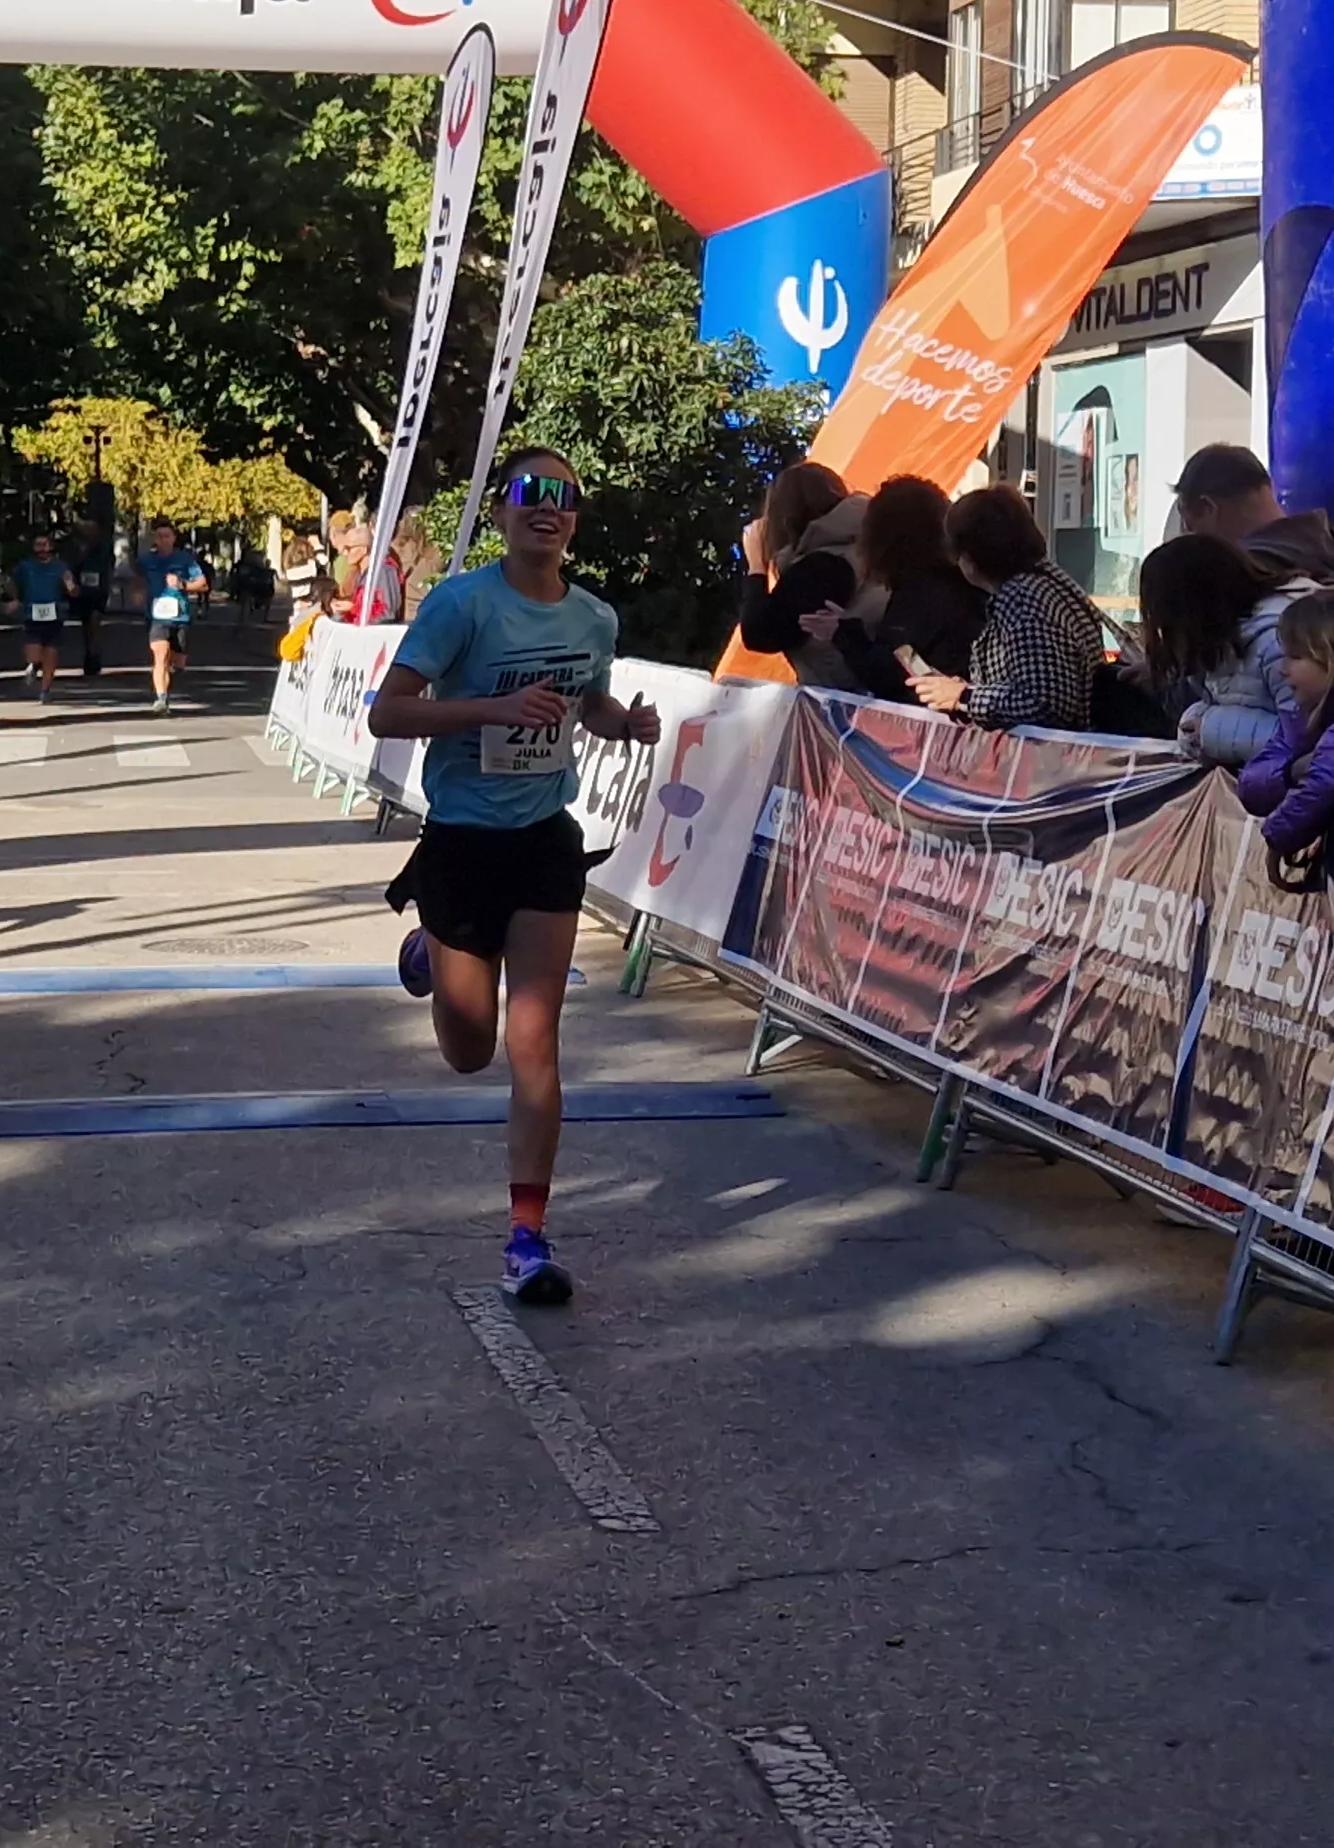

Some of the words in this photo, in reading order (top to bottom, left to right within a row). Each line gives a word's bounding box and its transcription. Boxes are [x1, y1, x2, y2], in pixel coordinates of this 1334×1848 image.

[859, 349, 984, 424] deporte
[874, 307, 1013, 394] Hacemos
[506, 723, 561, 746] 270
[514, 748, 552, 759] JULIA
[914, 836, 976, 905] ESIC
[1003, 856, 1084, 937] ESIC
[1119, 882, 1205, 972] ESIC
